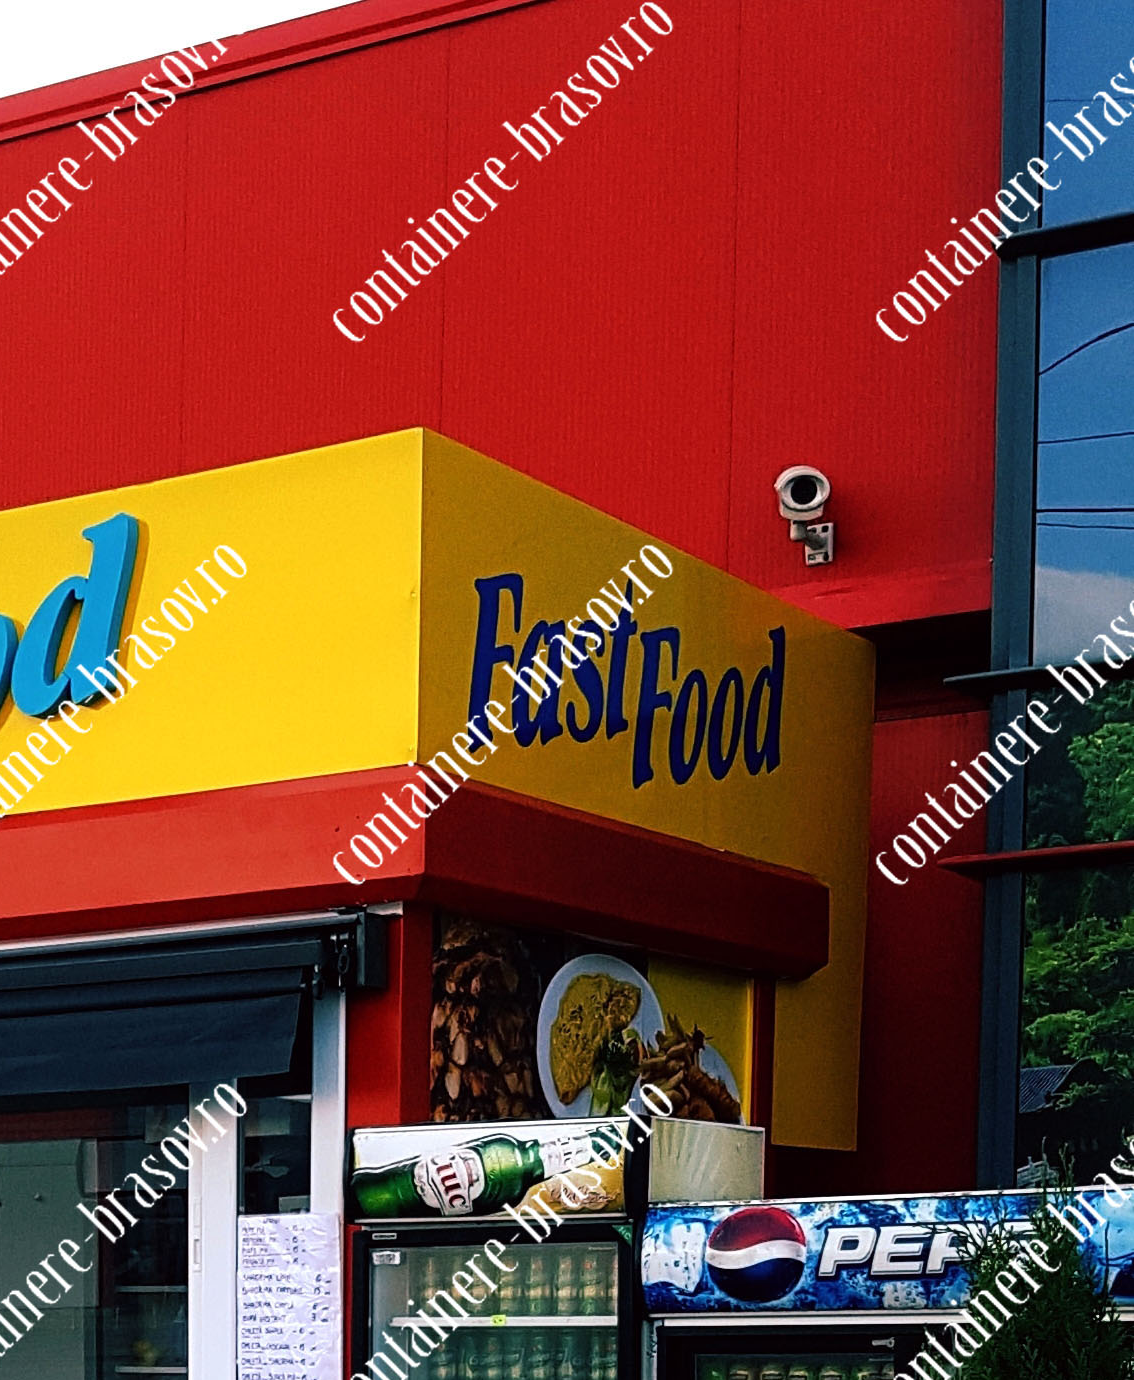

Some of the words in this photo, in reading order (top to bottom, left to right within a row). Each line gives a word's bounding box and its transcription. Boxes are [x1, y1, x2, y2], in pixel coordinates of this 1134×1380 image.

[467, 573, 638, 752] Fast
[632, 626, 785, 789] Food
[818, 1222, 1038, 1276] PEP
